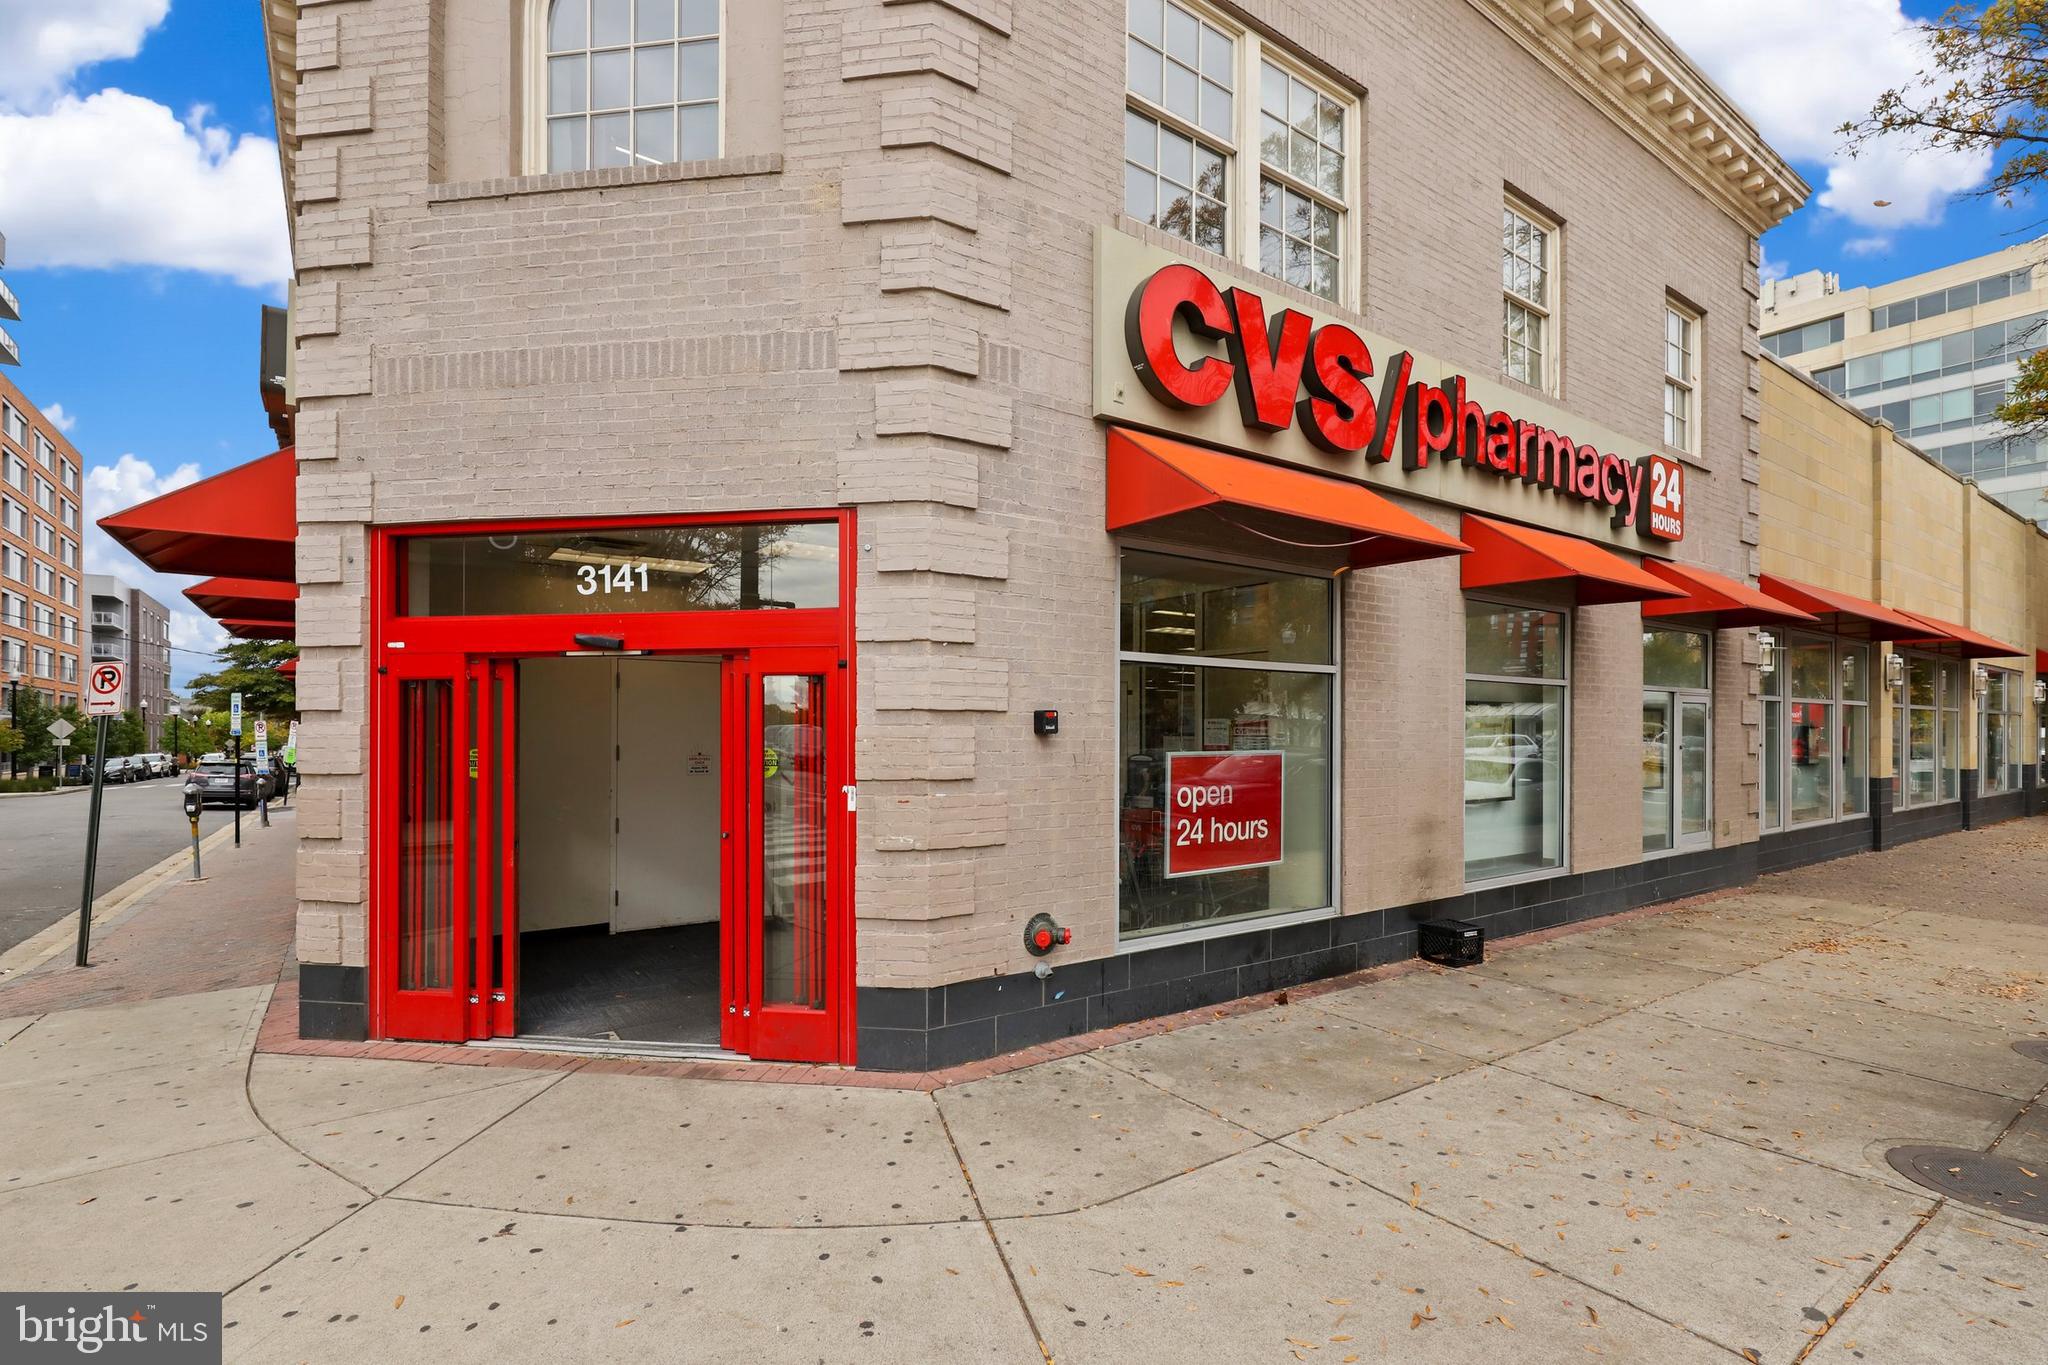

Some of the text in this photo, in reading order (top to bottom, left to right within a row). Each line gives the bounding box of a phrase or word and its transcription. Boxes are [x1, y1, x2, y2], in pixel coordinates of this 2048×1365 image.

[1652, 461, 1681, 513] 24
[1652, 511, 1681, 536] HOURS
[576, 562, 648, 596] 3141
[1176, 784, 1233, 813] open
[1176, 816, 1269, 846] 24 hours
